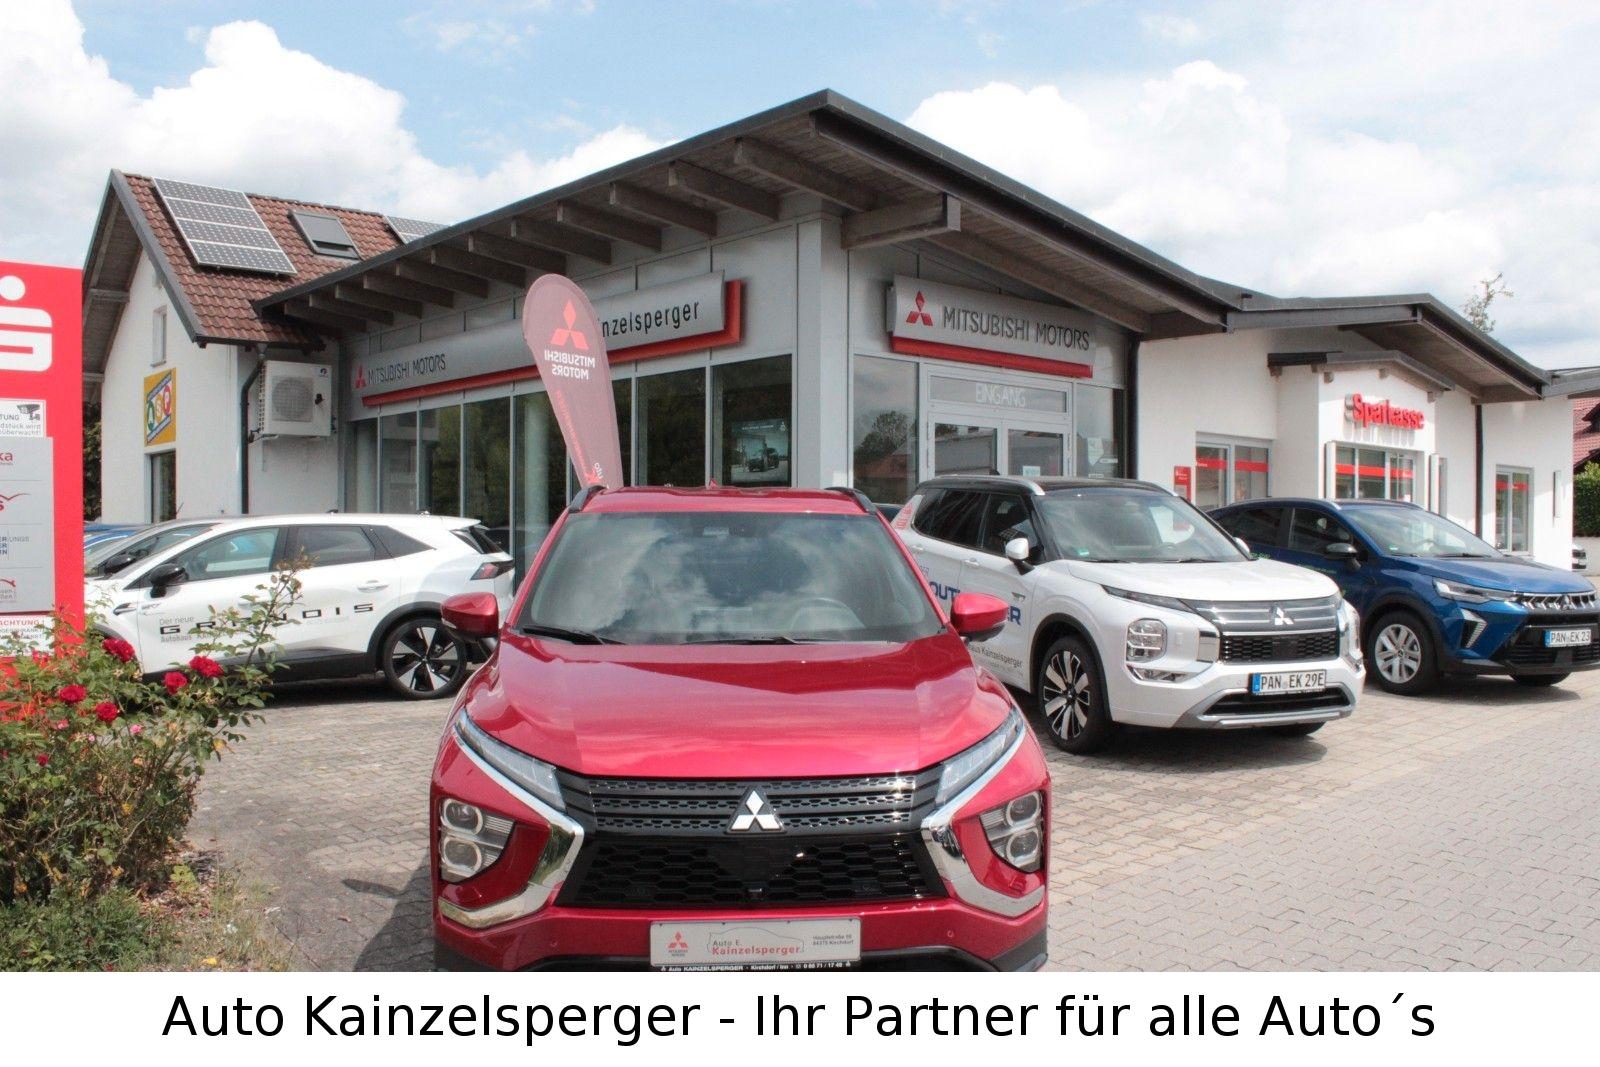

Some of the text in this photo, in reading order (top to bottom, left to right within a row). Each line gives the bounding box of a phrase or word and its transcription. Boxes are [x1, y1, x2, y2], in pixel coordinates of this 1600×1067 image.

[602, 301, 699, 337] nzelsperger
[942, 306, 1090, 351] MITSUBISHI MOTORS
[368, 353, 446, 384] MITSUBISHI MOTORS
[975, 382, 1026, 407] EINGANG
[1353, 393, 1424, 429] Sparkasse
[1551, 632, 1566, 643] PAN
[1262, 672, 1324, 690] PAN EK 29E
[712, 945, 800, 956] Kainzelsperger
